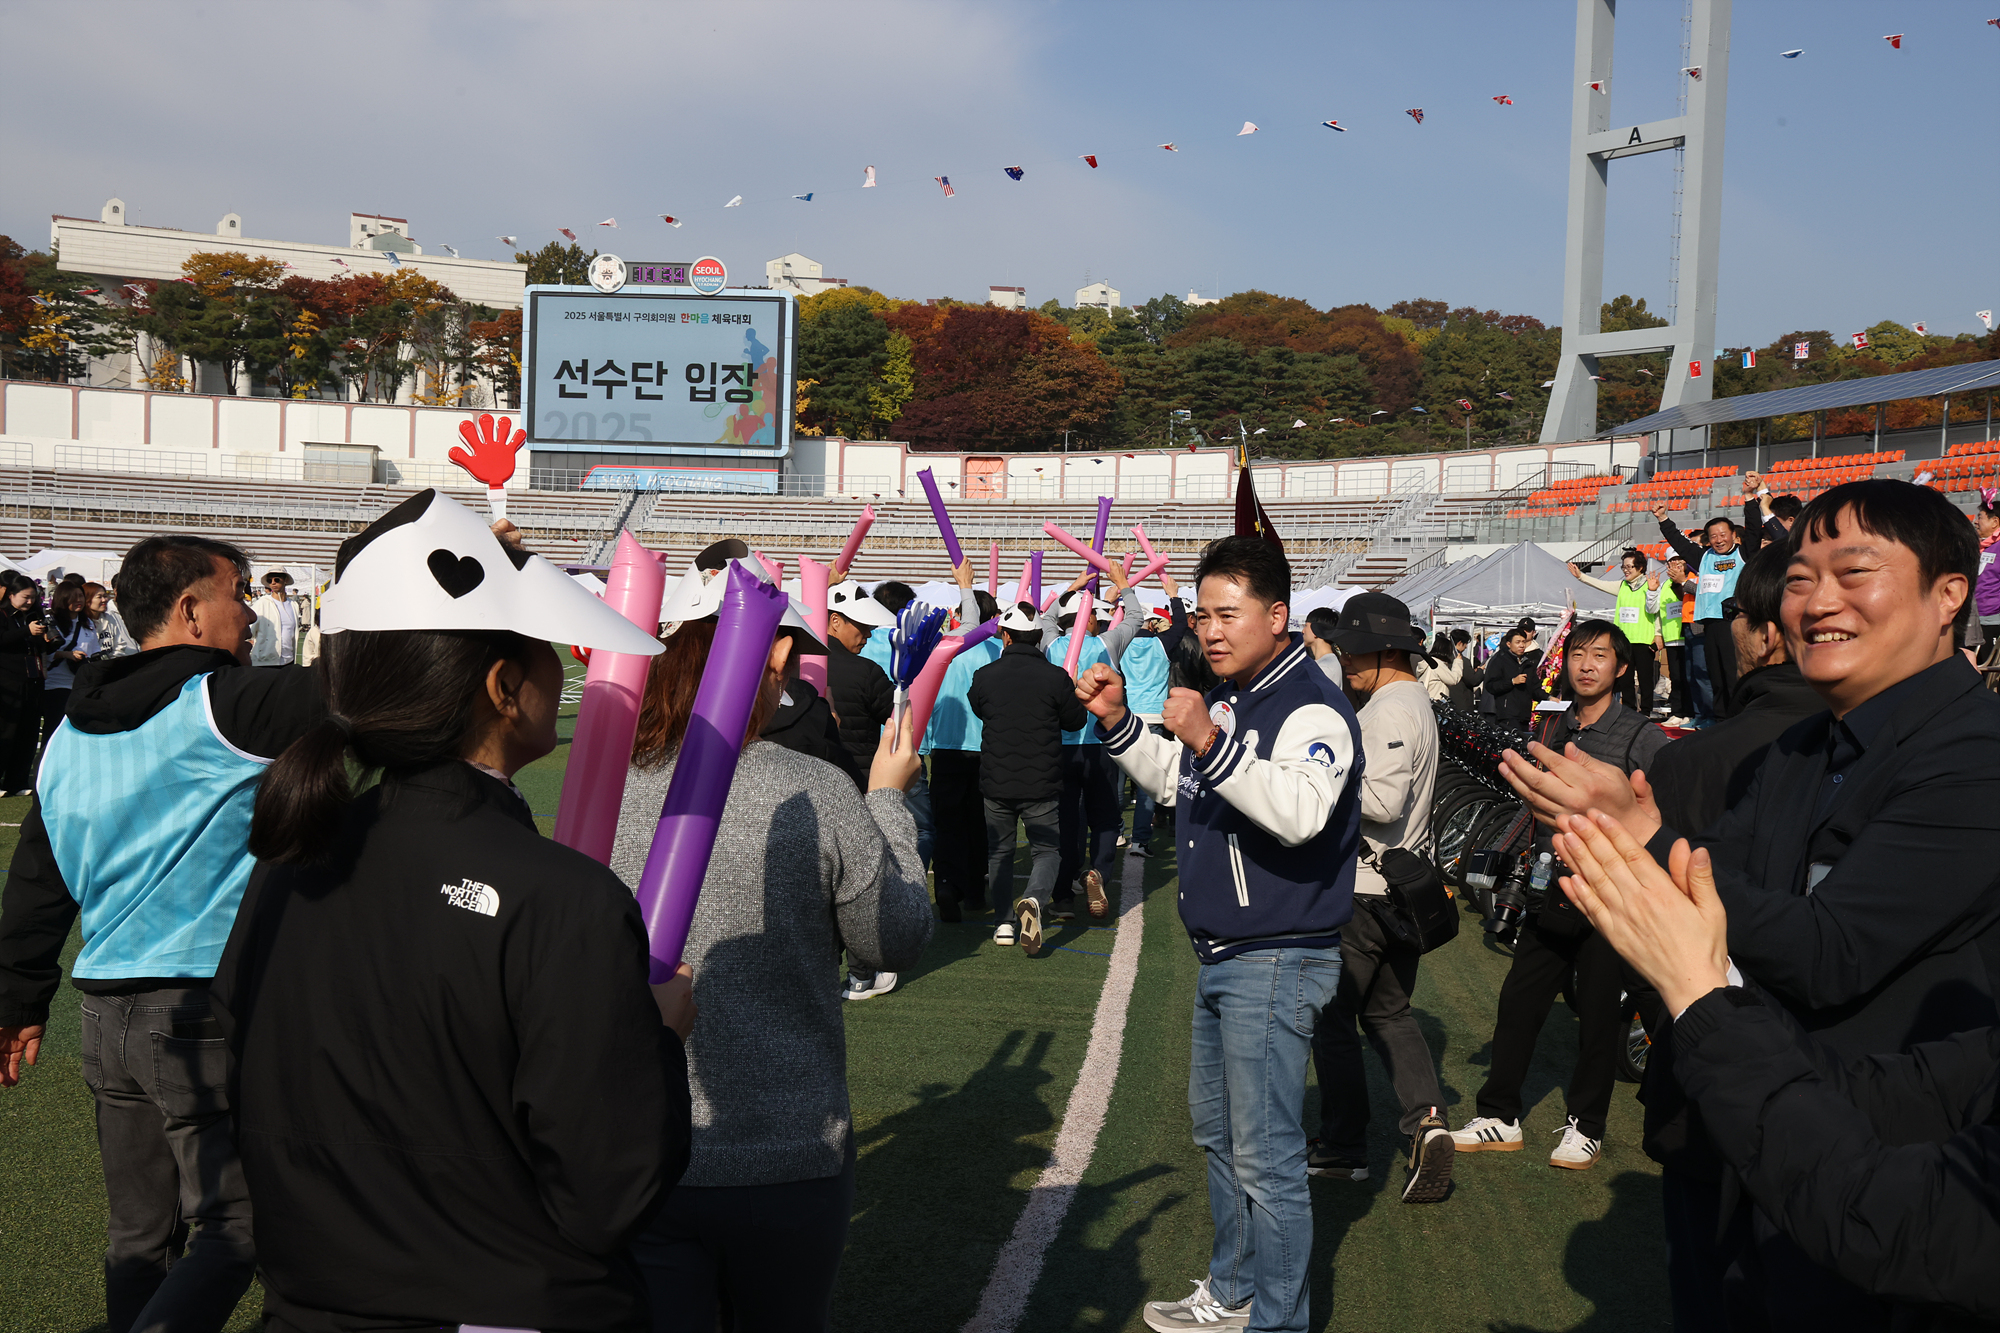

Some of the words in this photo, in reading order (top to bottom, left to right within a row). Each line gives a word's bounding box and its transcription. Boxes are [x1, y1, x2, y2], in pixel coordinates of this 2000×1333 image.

[1628, 126, 1642, 145] A
[636, 266, 685, 283] 10:34
[695, 266, 722, 275] SEOUL
[564, 311, 586, 321] 2025
[588, 311, 631, 322] 서울특별시
[633, 312, 676, 323] 구의회의원
[680, 312, 709, 324] 한마음
[711, 313, 752, 325] 체육대회
[552, 359, 668, 401] 선수단
[685, 362, 759, 404] 입장
[543, 410, 653, 442] 2025
[600, 473, 641, 487] SEOUL
[646, 474, 723, 488] HYOCHANG
[440, 883, 481, 902] NORTH
[462, 878, 485, 893] THE
[447, 895, 478, 912] FACE
